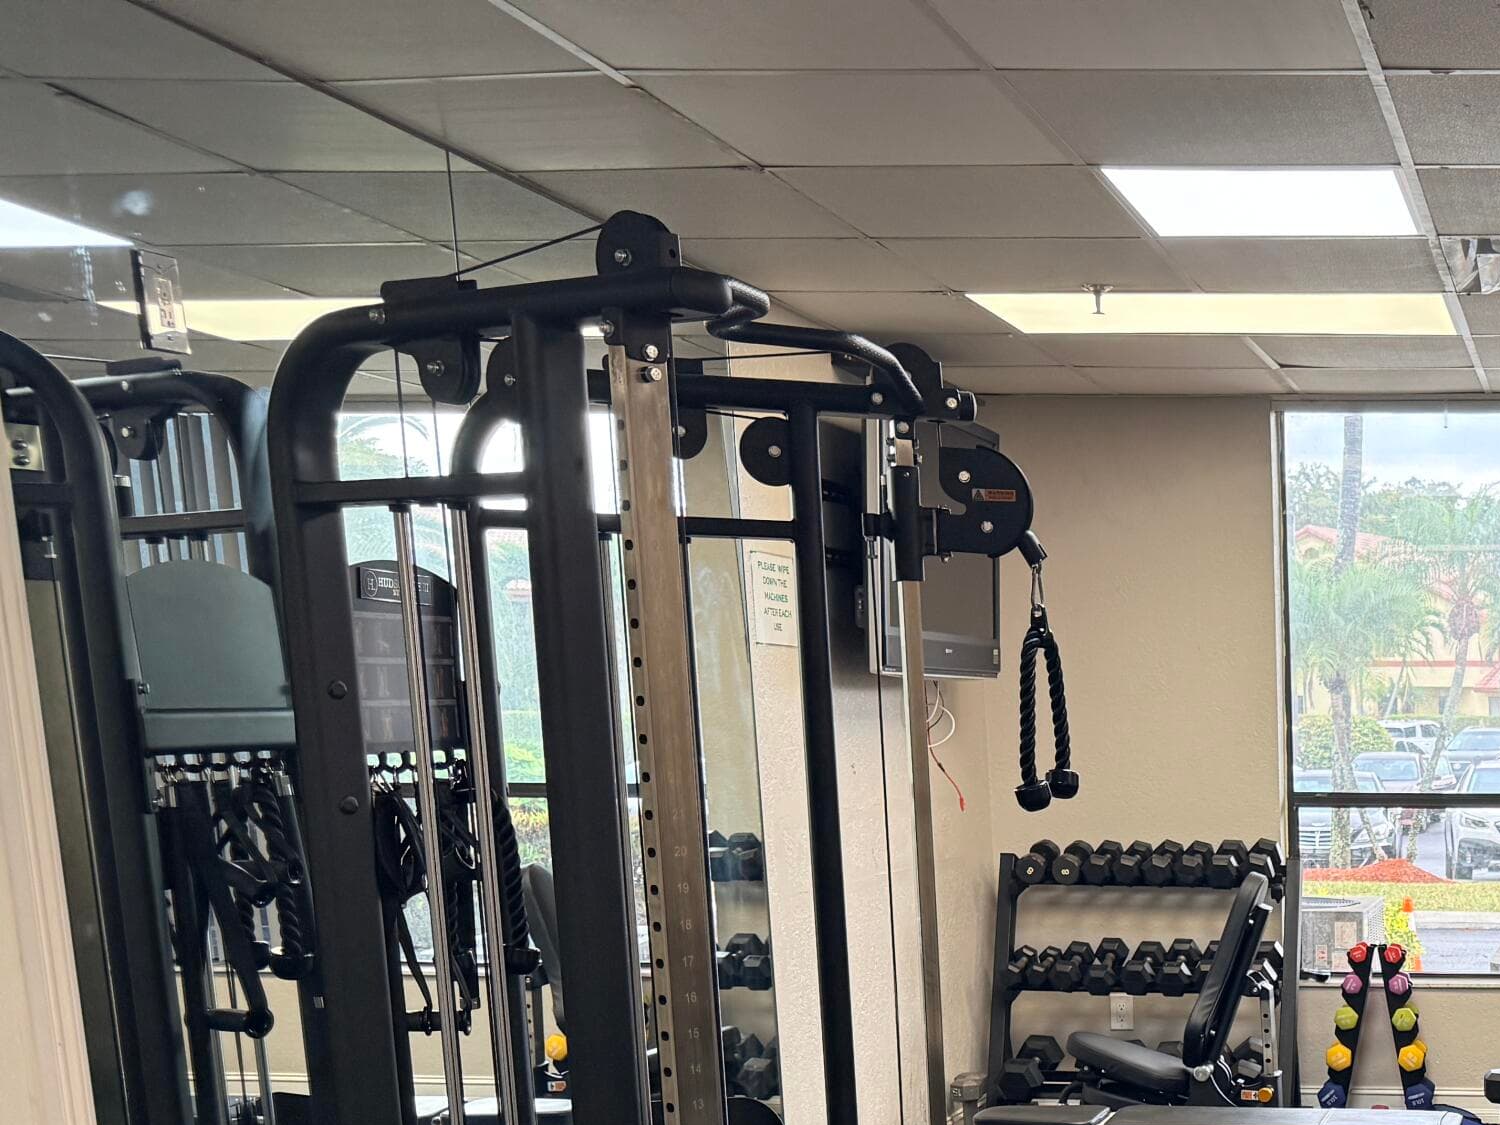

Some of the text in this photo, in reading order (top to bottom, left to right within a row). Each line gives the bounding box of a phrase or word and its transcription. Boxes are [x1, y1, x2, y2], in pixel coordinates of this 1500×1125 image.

[758, 561, 790, 575] PLEASE WIPE
[763, 576, 788, 589] DOWN THE
[764, 591, 789, 603] MACHINES
[764, 607, 792, 618] AFTER EACH
[674, 846, 687, 857] 20
[677, 883, 689, 894] 19
[682, 956, 694, 967] 17
[685, 992, 697, 1003] 16
[690, 1063, 702, 1074] 14
[692, 1099, 705, 1110] 13
